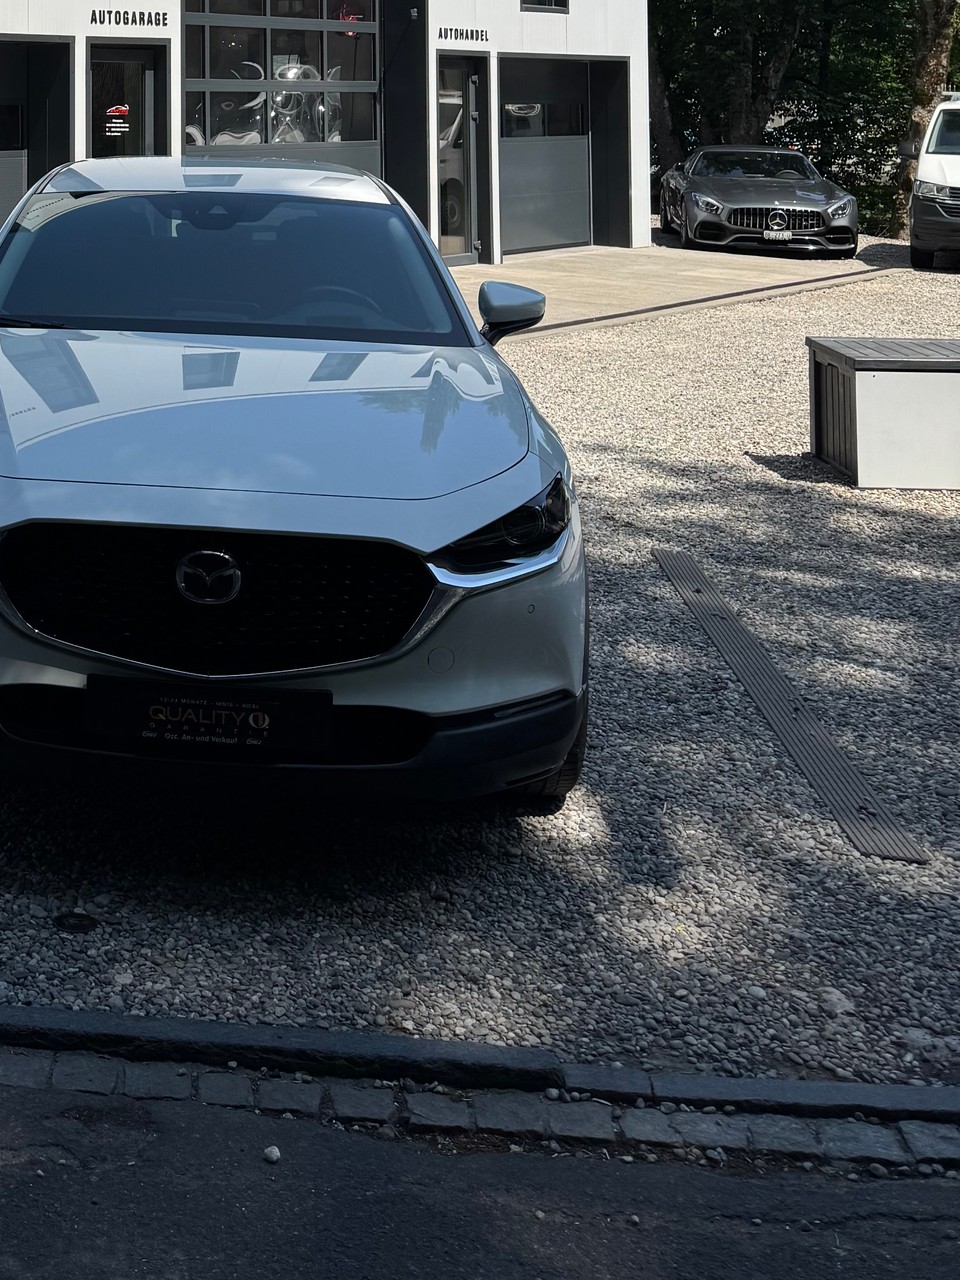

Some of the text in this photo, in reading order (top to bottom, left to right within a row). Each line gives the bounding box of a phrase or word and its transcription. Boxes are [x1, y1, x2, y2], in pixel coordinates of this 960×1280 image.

[90, 9, 168, 27] AUTOGARAGE
[438, 27, 489, 42] AUTOHANDEL
[148, 705, 246, 727] QUALITY
[211, 736, 238, 744] Verkauf
